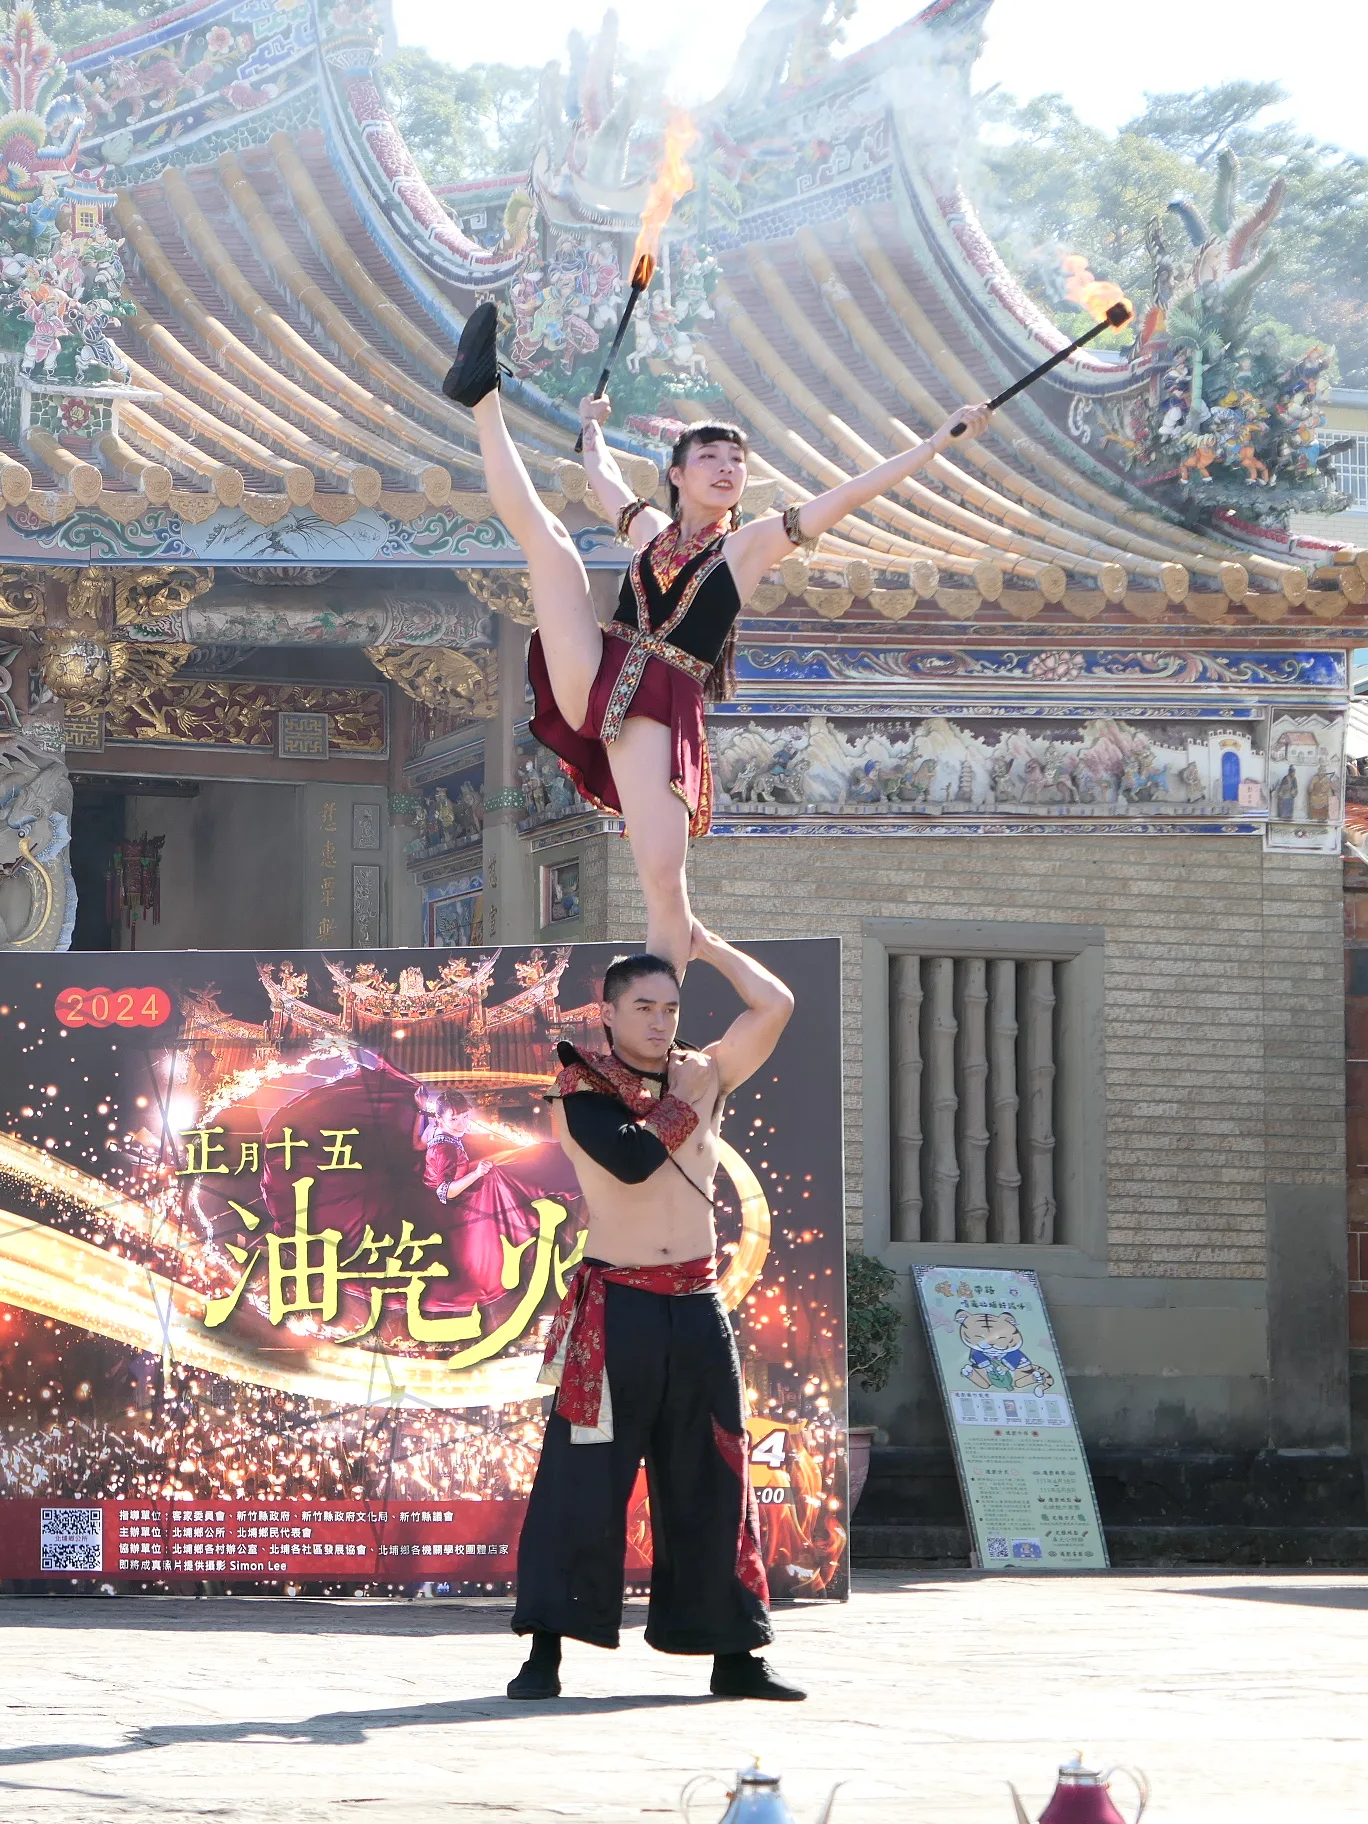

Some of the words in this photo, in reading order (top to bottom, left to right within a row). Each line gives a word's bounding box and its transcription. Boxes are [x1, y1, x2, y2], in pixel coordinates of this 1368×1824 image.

[66, 993, 159, 1021] 2024
[175, 1126, 363, 1175] 正月十五
[746, 1430, 786, 1468] 4
[230, 1561, 264, 1571] Simon
[268, 1561, 287, 1571] Lee
